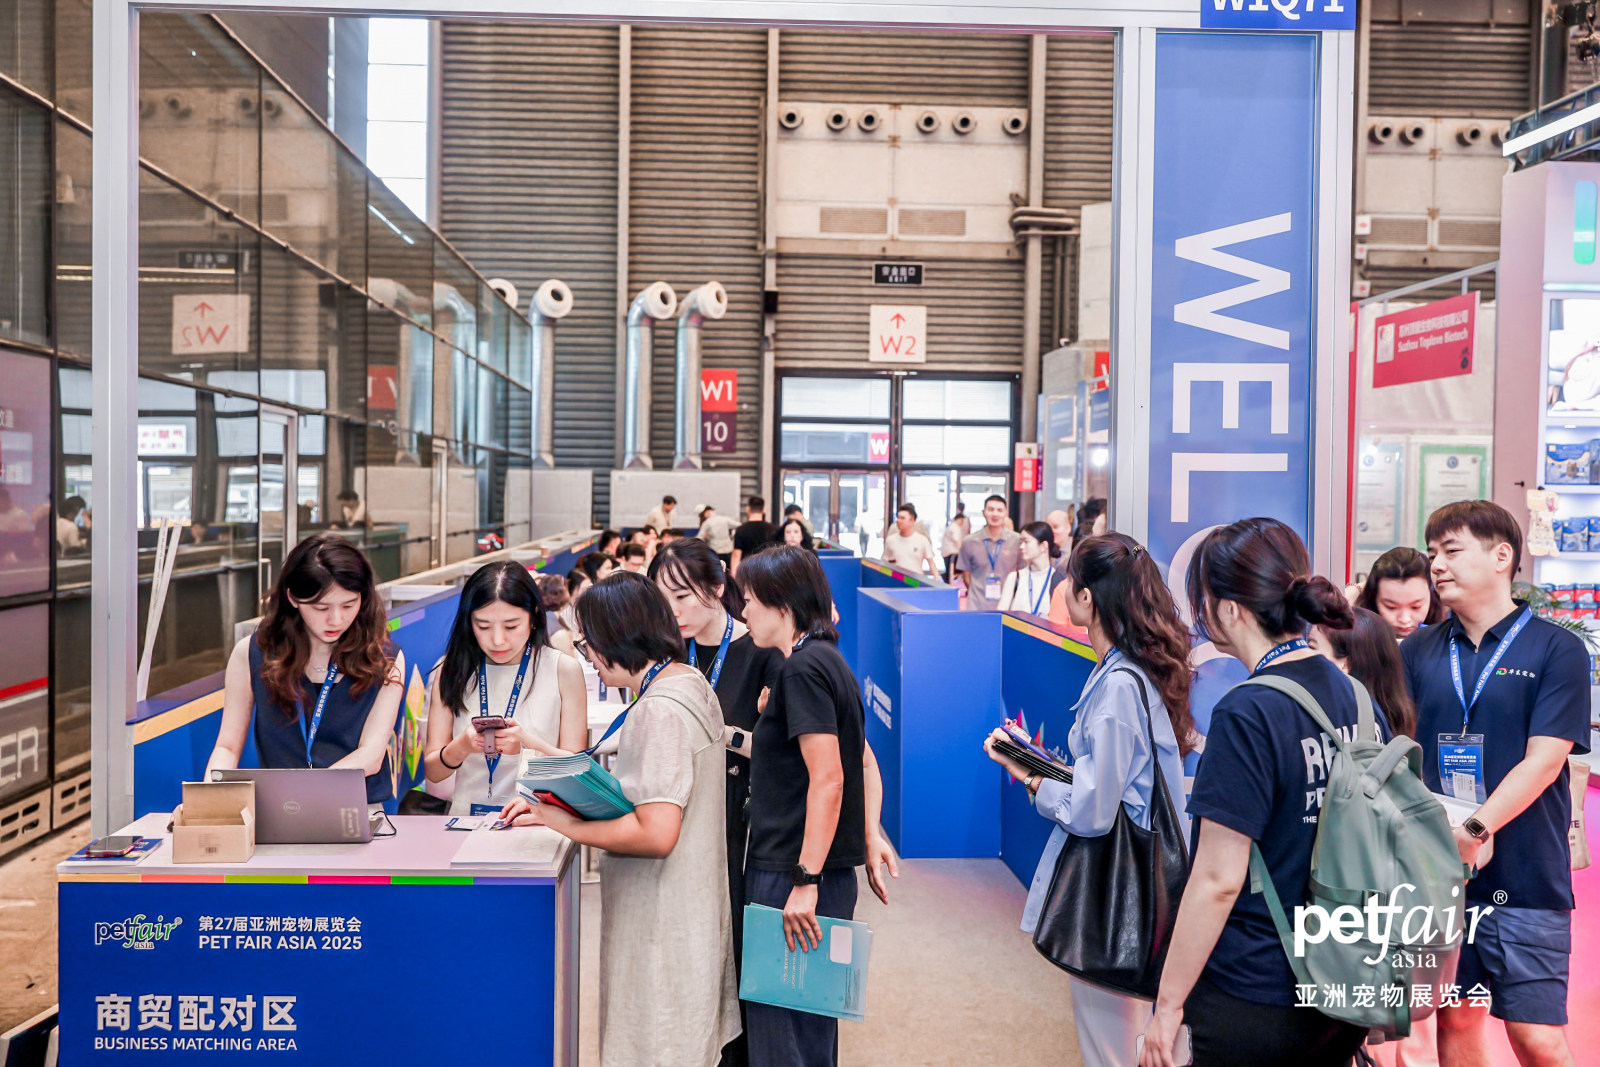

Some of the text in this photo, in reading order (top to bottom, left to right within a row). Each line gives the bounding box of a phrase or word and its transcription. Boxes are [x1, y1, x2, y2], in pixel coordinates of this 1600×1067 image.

[880, 334, 917, 355] W2
[701, 379, 733, 401] W1
[703, 421, 729, 442] 10
[1267, 648, 1279, 660] Fair
[1279, 643, 1291, 653] Pet
[1302, 815, 1318, 824] THE
[198, 916, 362, 932] 第27届亚洲宠物展览会
[134, 940, 154, 949] asia
[199, 936, 362, 950] PET FAIR ASIA 2025
[95, 993, 298, 1031] 商贸配对区
[94, 1037, 298, 1051] BUSINESS MATCHING AREA
